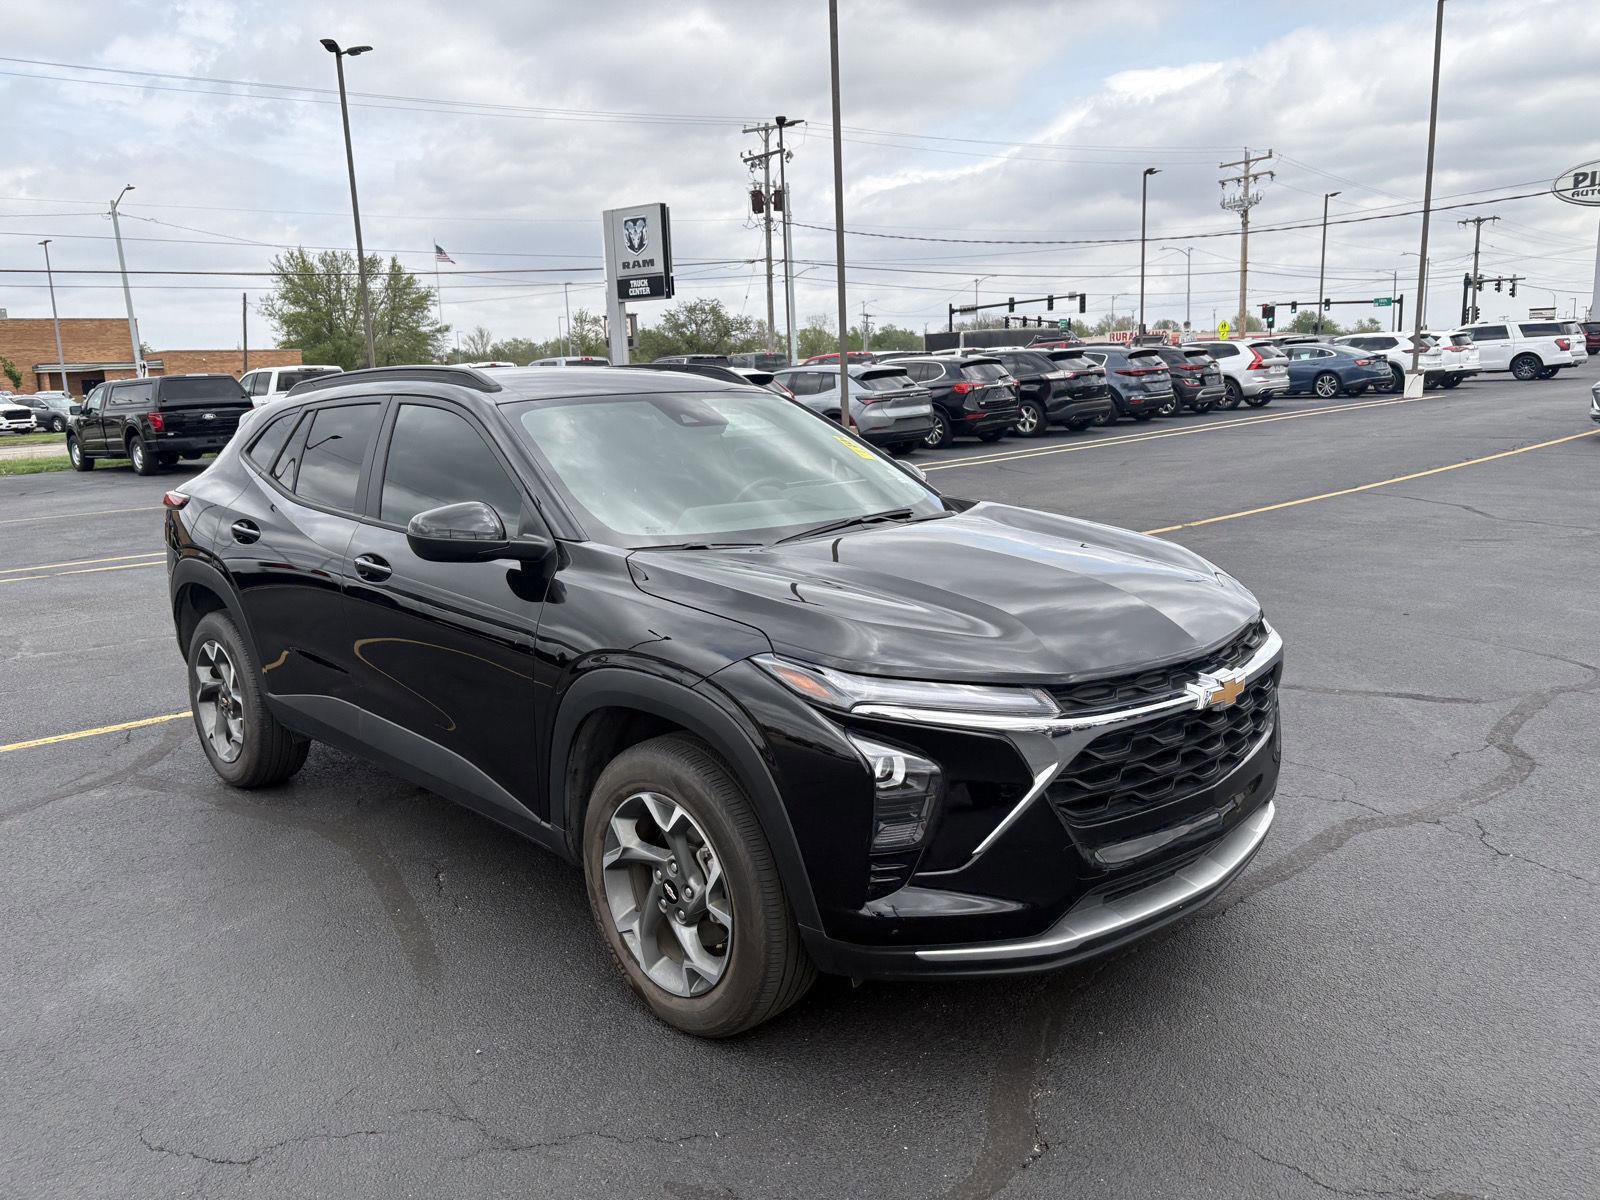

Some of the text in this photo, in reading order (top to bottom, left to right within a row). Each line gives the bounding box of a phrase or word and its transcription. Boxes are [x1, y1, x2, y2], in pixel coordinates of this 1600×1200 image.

[1573, 171, 1600, 188] PI
[622, 259, 655, 269] RAM
[629, 279, 649, 288] TRUCK
[628, 286, 651, 296] CENTER
